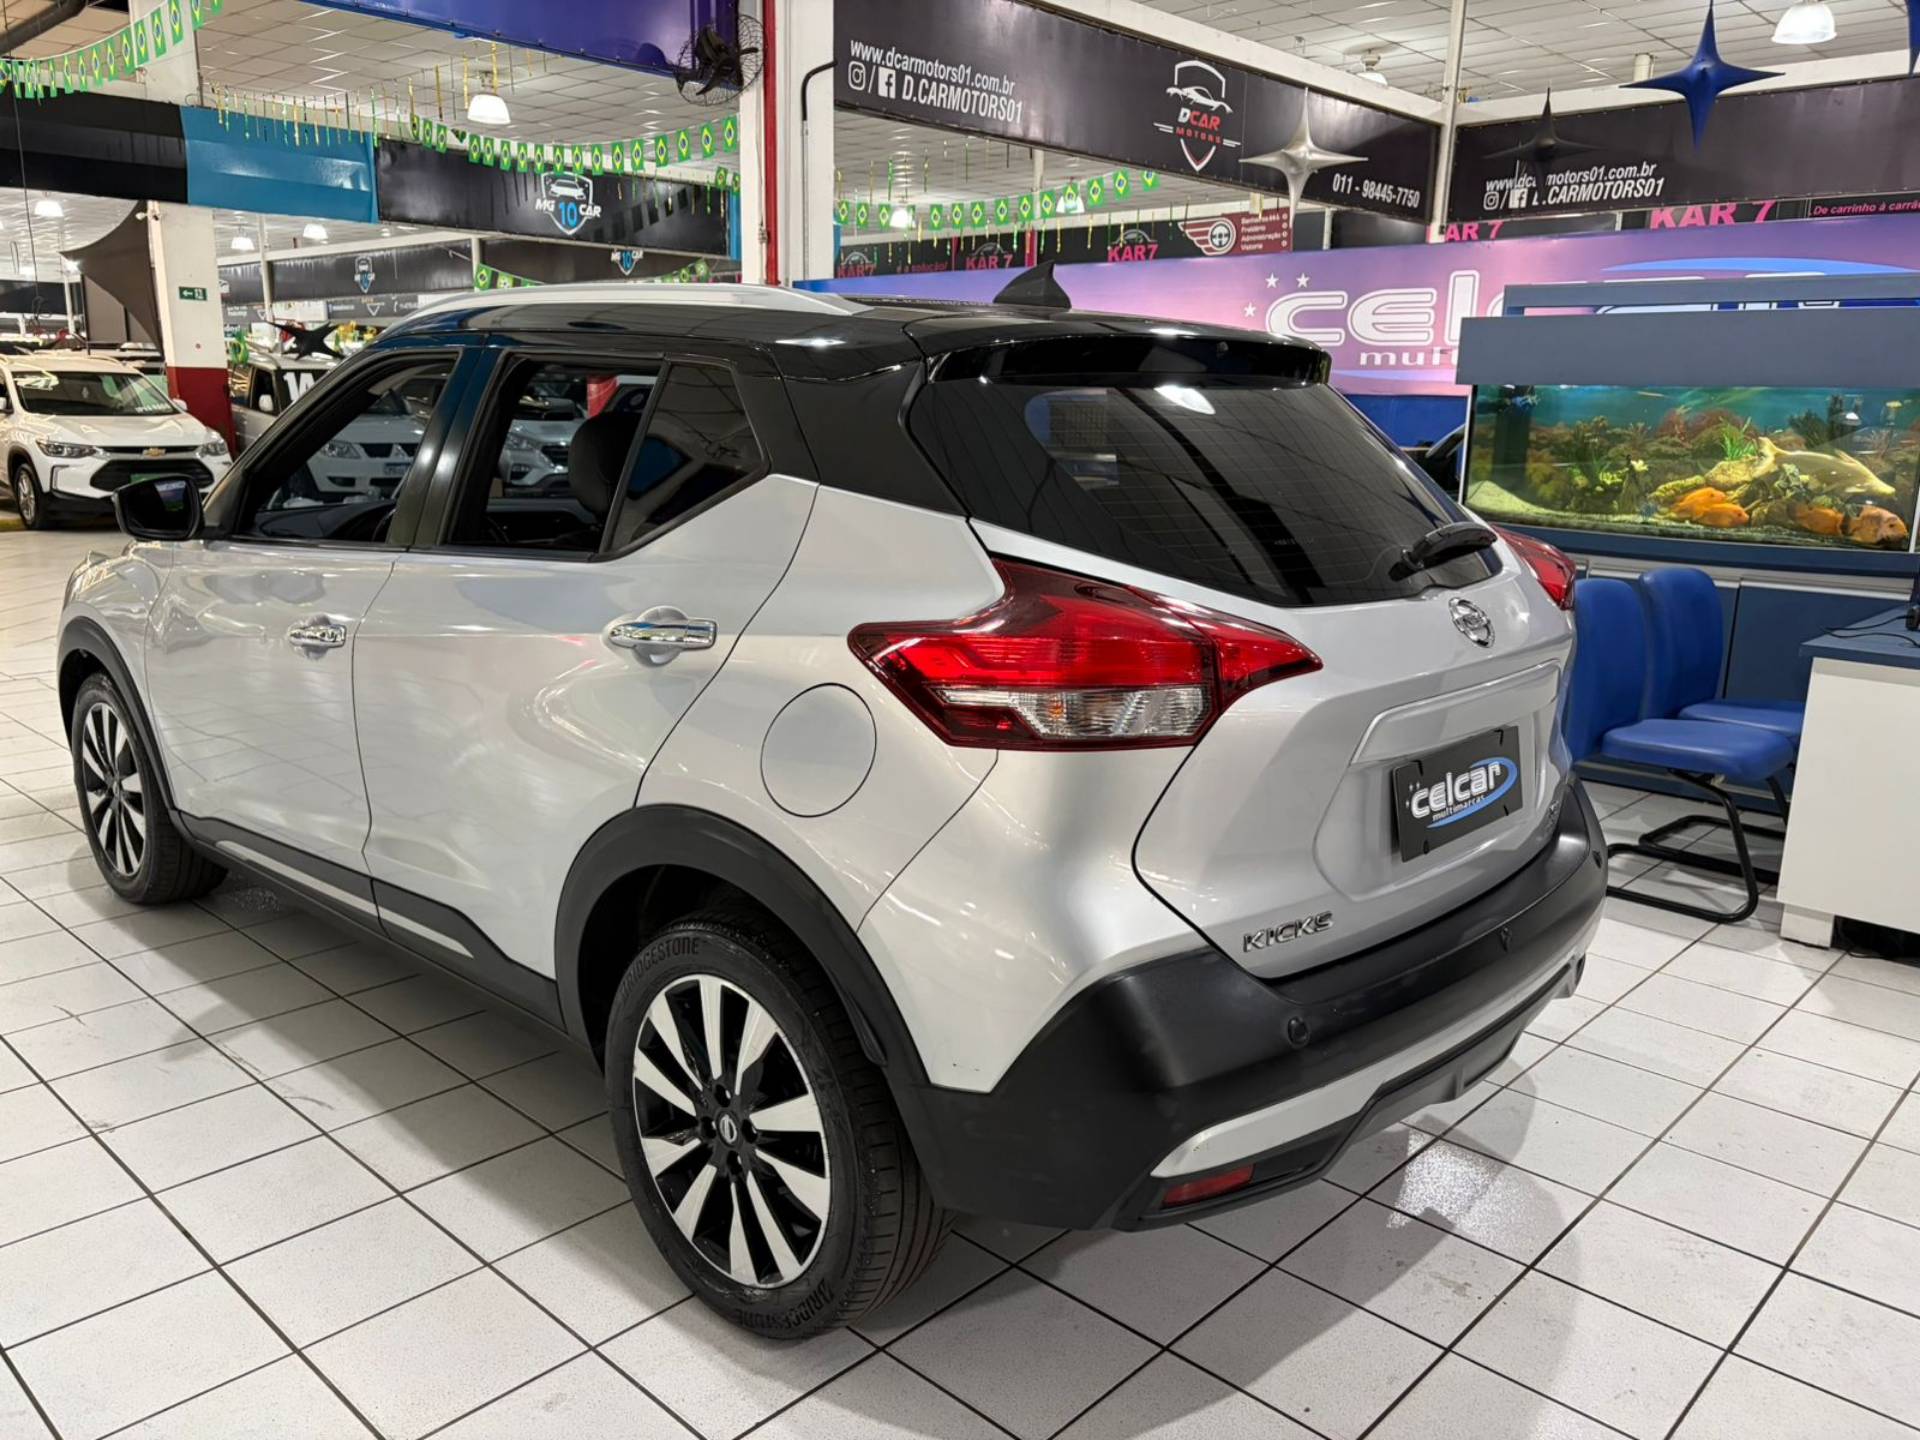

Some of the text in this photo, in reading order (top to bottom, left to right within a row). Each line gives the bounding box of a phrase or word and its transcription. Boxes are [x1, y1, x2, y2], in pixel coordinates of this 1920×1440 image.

[850, 40, 1015, 96] www.dcarmotors01.com.br
[902, 75, 1023, 123] D.CARMOTORS01
[1178, 107, 1221, 131] DCAR
[1176, 127, 1221, 143] MOTORS
[1332, 173, 1353, 194] 011
[1362, 180, 1420, 208] 98445-7750
[1486, 161, 1657, 192] www.dcmotors01.com.br
[534, 200, 601, 227] MG 10 CAR
[1752, 201, 1774, 223] 7
[1830, 203, 1876, 214] carrinho
[1486, 221, 1504, 239] 7
[1411, 761, 1501, 819] celcar
[1243, 911, 1334, 952] KICKS
